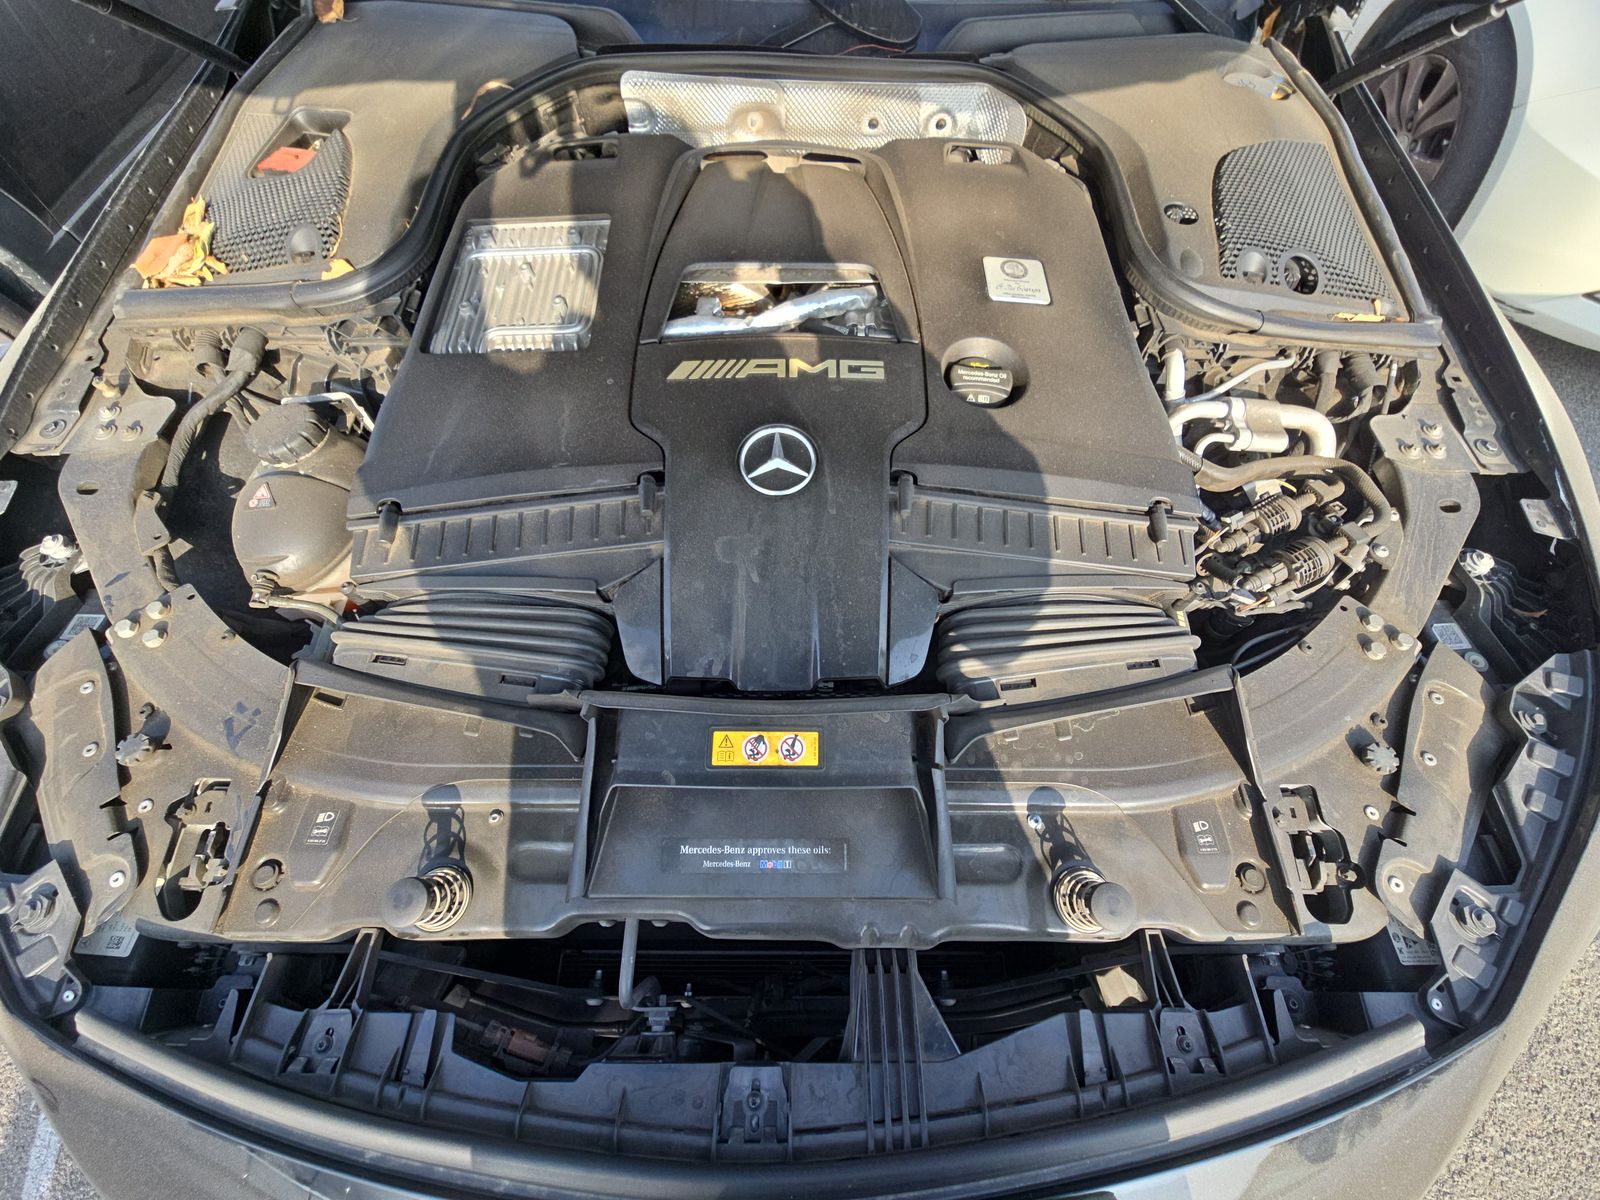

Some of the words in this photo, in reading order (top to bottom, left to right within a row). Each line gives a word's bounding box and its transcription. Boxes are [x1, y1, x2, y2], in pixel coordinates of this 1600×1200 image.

[736, 358, 885, 380] AMG
[957, 369, 998, 378] Mercedes-Benz
[679, 845, 745, 854] Mercedes-Benz
[747, 846, 786, 856] approves
[788, 845, 812, 854] these
[813, 845, 831, 854] oils:
[702, 860, 751, 868] Mercedes-Benz
